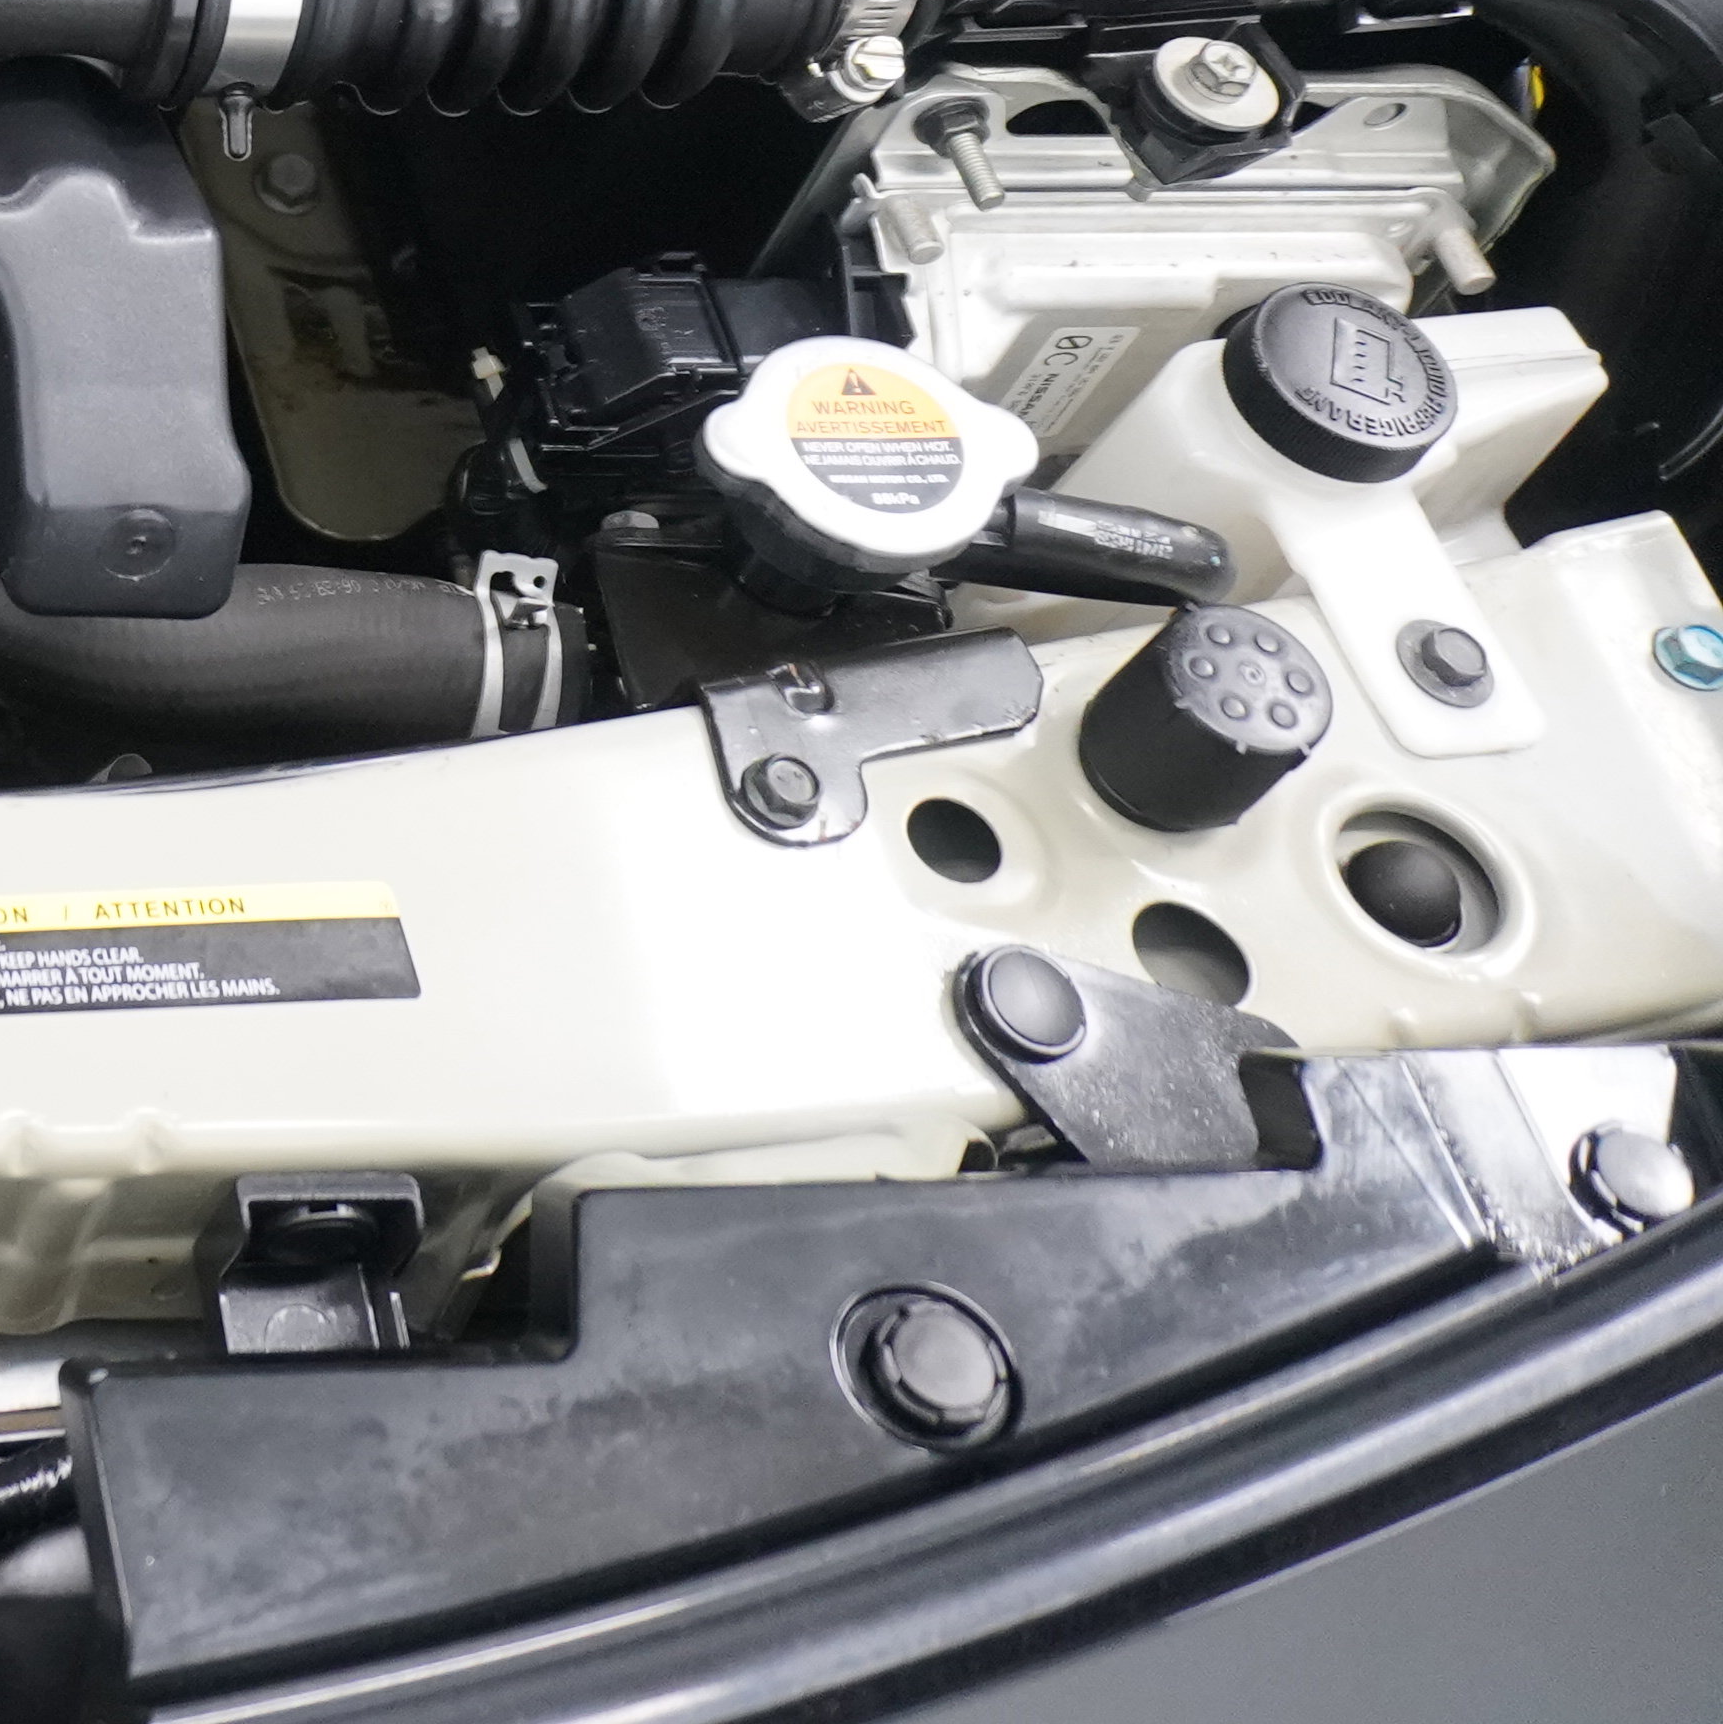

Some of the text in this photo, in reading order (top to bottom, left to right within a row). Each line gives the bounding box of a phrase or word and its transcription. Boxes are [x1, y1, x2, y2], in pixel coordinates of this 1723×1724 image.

[812, 400, 916, 415] WARNING
[797, 420, 947, 434] AVERTISSEMENT
[802, 441, 845, 453] NEVER
[846, 441, 882, 453] OPEN
[882, 441, 923, 453] WHEN
[95, 897, 246, 921] ATTENTION
[0, 950, 38, 970] KEEP
[38, 948, 91, 968] HANDS
[91, 946, 144, 966] CLEAR.
[81, 965, 124, 984] TOUT
[125, 961, 206, 982] MOMENT.
[5, 988, 29, 1007] NE
[30, 986, 64, 1006] PAS
[65, 985, 89, 1004] EN
[89, 982, 190, 1003] APPROCHER
[189, 980, 221, 999] LES
[222, 978, 281, 998] MAINS.
